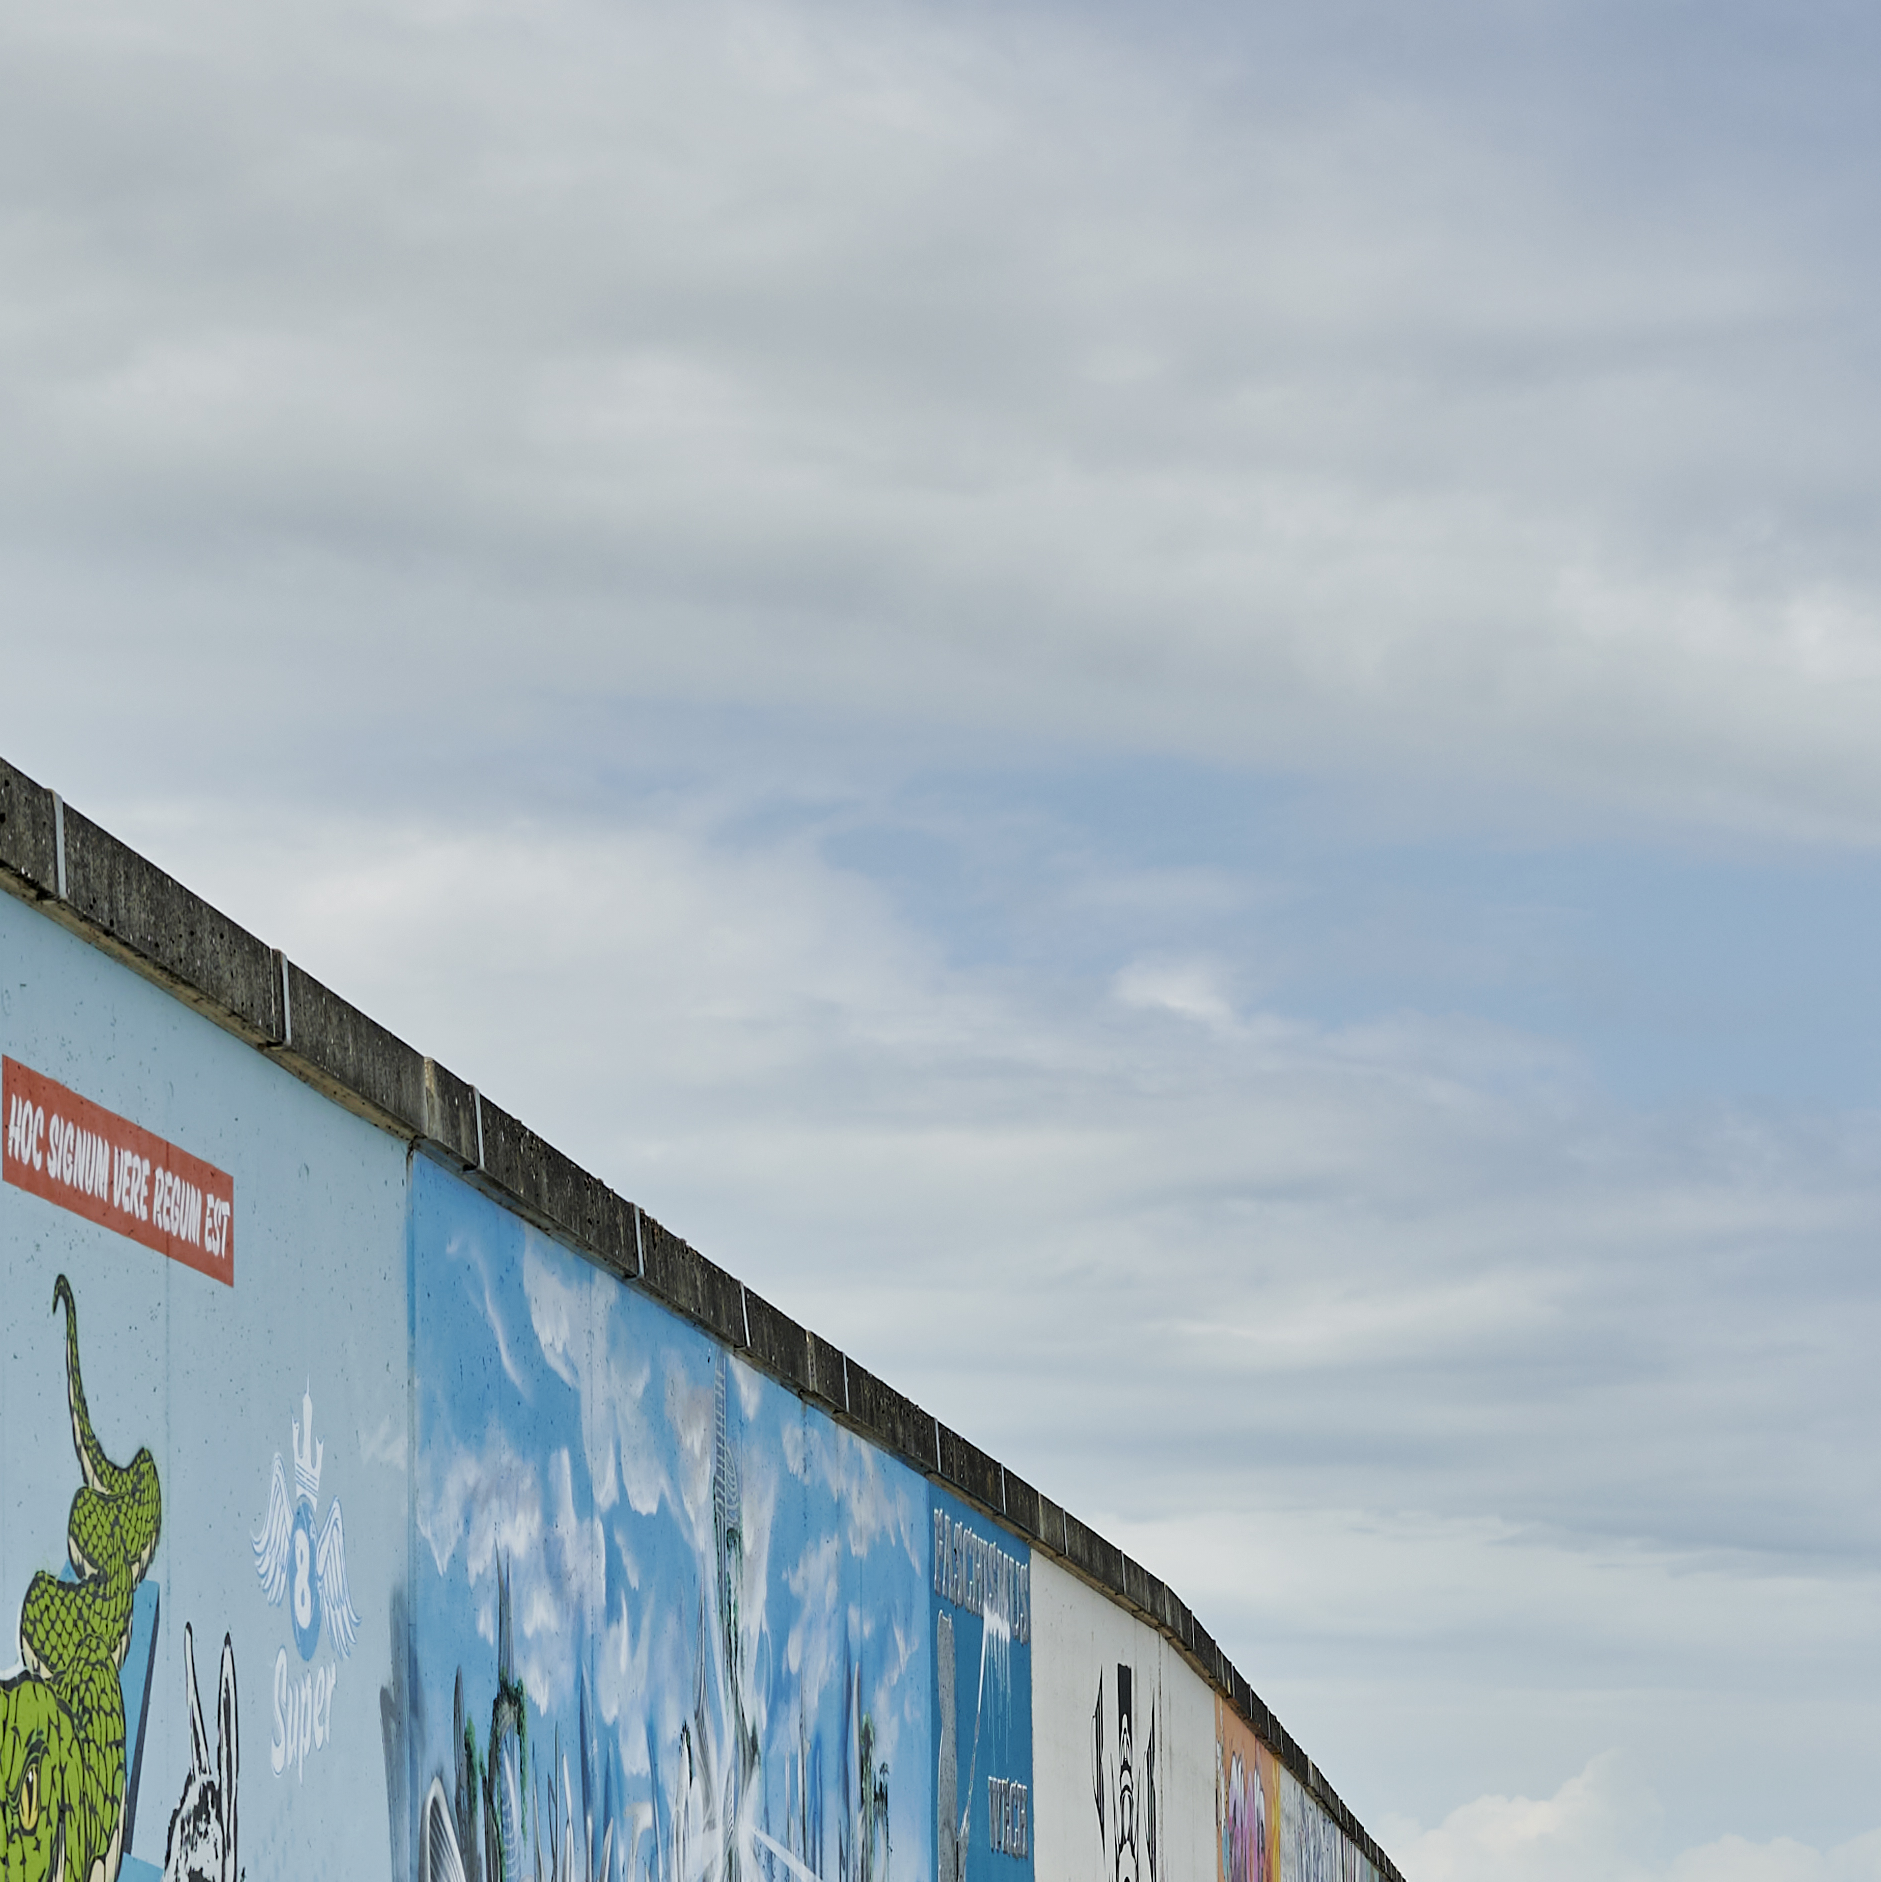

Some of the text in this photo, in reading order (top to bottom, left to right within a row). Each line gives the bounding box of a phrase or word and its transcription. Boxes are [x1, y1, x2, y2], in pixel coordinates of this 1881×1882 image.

[8, 1093, 231, 1259] HOC SIGNUM VERE REGUM EST
[933, 1507, 1031, 1646] FASCHISMUS
[270, 1644, 338, 1785] Super
